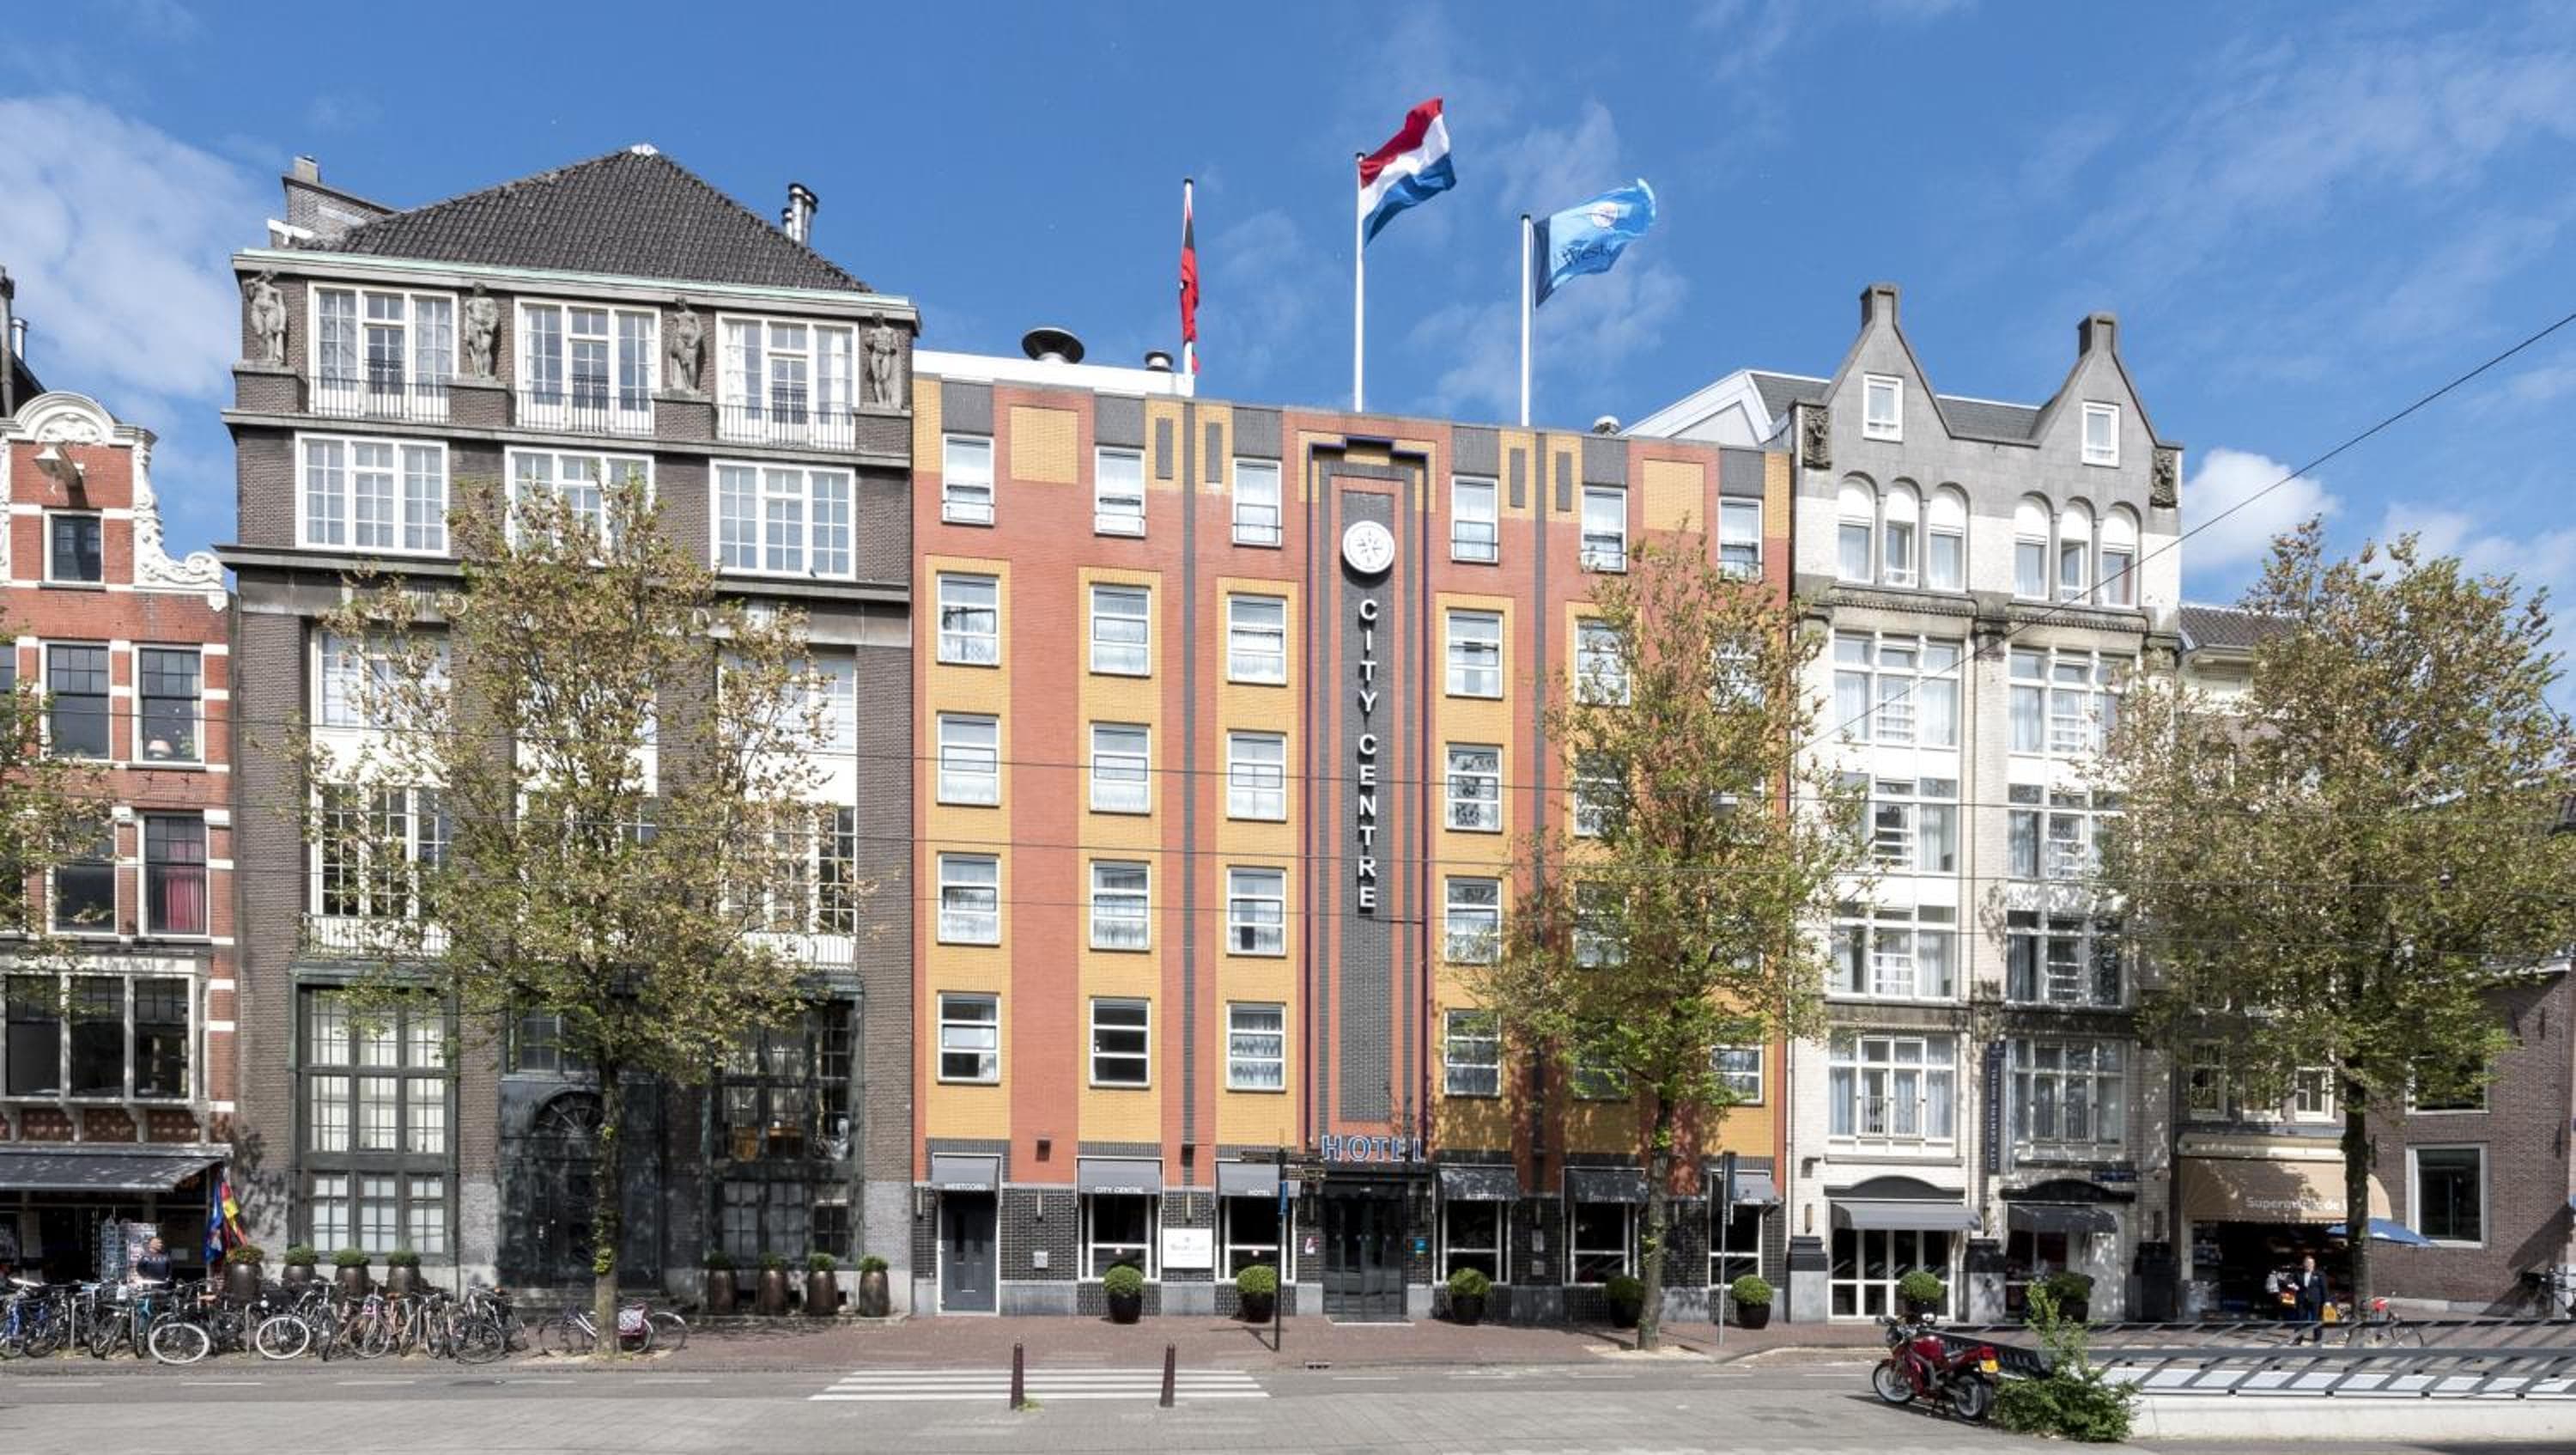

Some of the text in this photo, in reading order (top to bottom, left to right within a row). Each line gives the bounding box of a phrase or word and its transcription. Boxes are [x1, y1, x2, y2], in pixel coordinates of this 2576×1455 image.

[1358, 599, 1378, 908] CITY CENTRE
[1322, 1135, 1426, 1163] HOTEL
